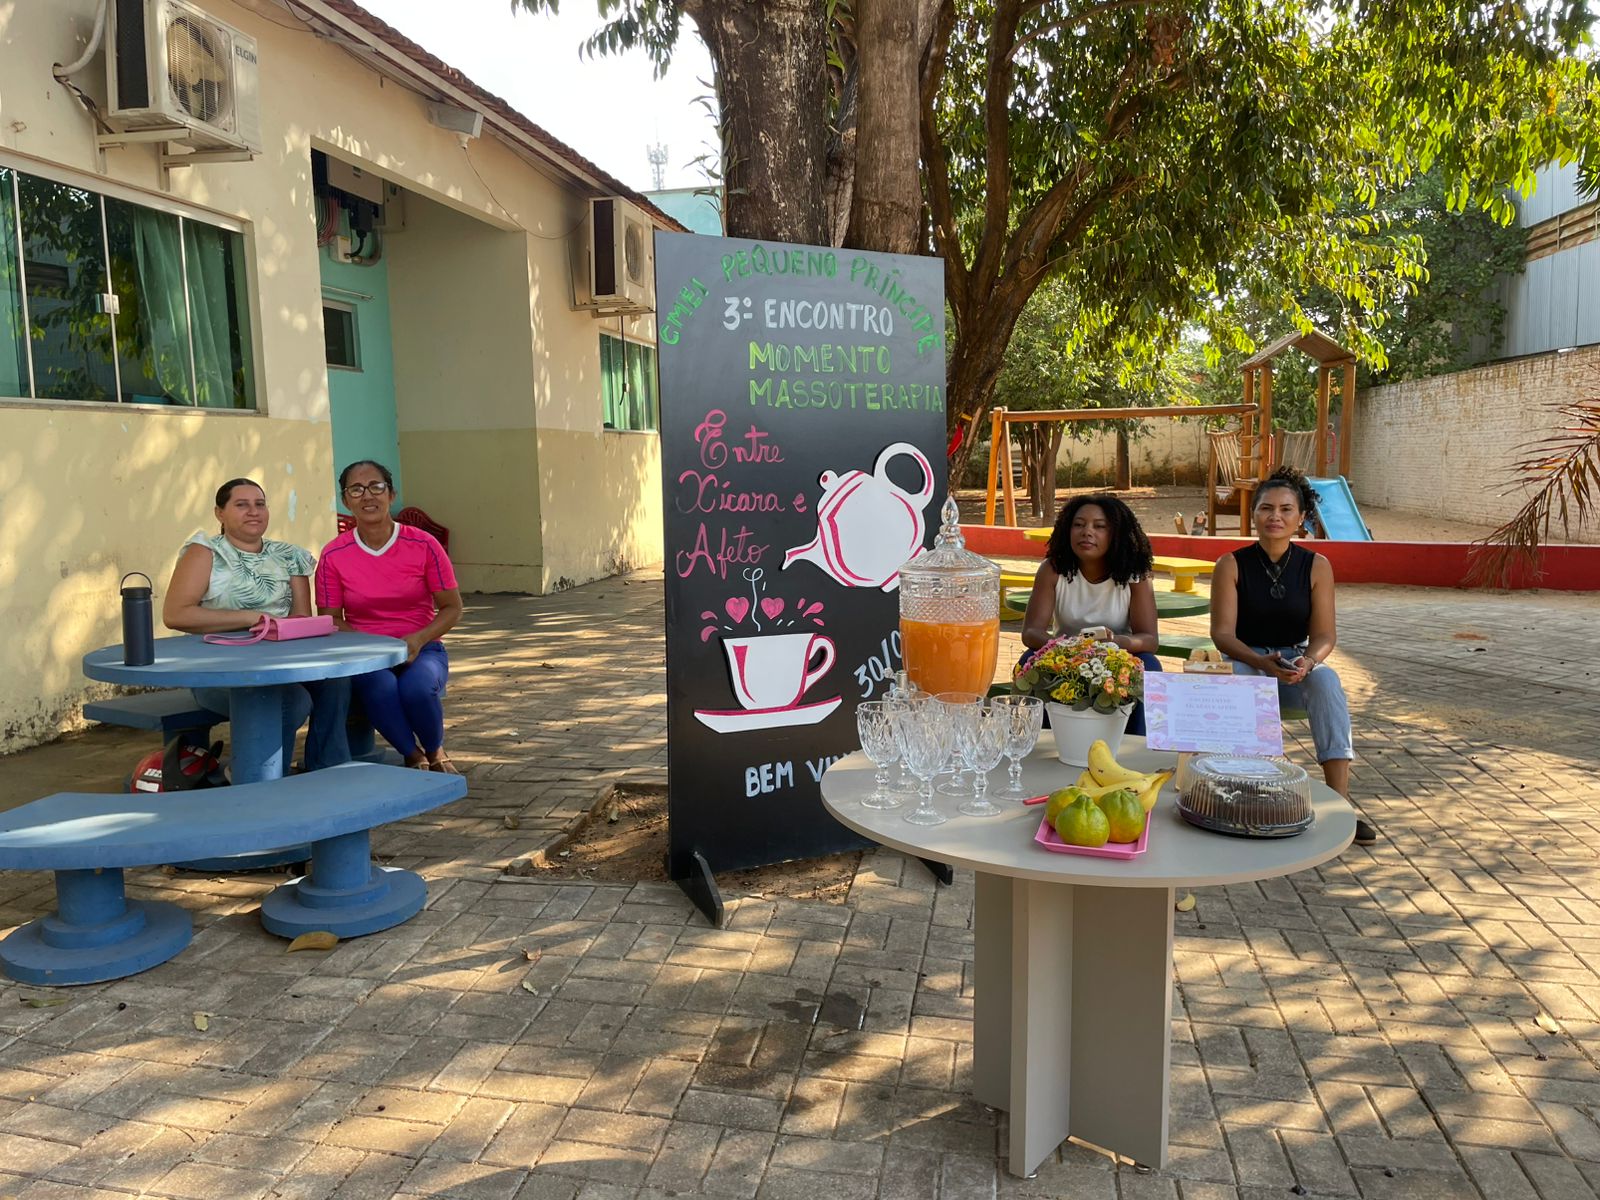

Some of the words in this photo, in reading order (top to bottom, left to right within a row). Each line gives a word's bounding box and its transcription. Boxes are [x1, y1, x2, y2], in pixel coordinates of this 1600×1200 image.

[235, 45, 257, 65] ELGIN
[659, 277, 709, 345] CMEI
[720, 244, 838, 282] PEQUENO
[764, 298, 893, 337] ENCONTRO
[749, 341, 891, 374] MOMENTO
[749, 378, 944, 413] MASSOTERAPIA
[694, 409, 785, 470] Entre
[676, 470, 786, 513] Xícara
[792, 493, 807, 512] e
[676, 522, 771, 580] Afeto
[853, 630, 902, 698] 30/0
[745, 761, 794, 797] BEM
